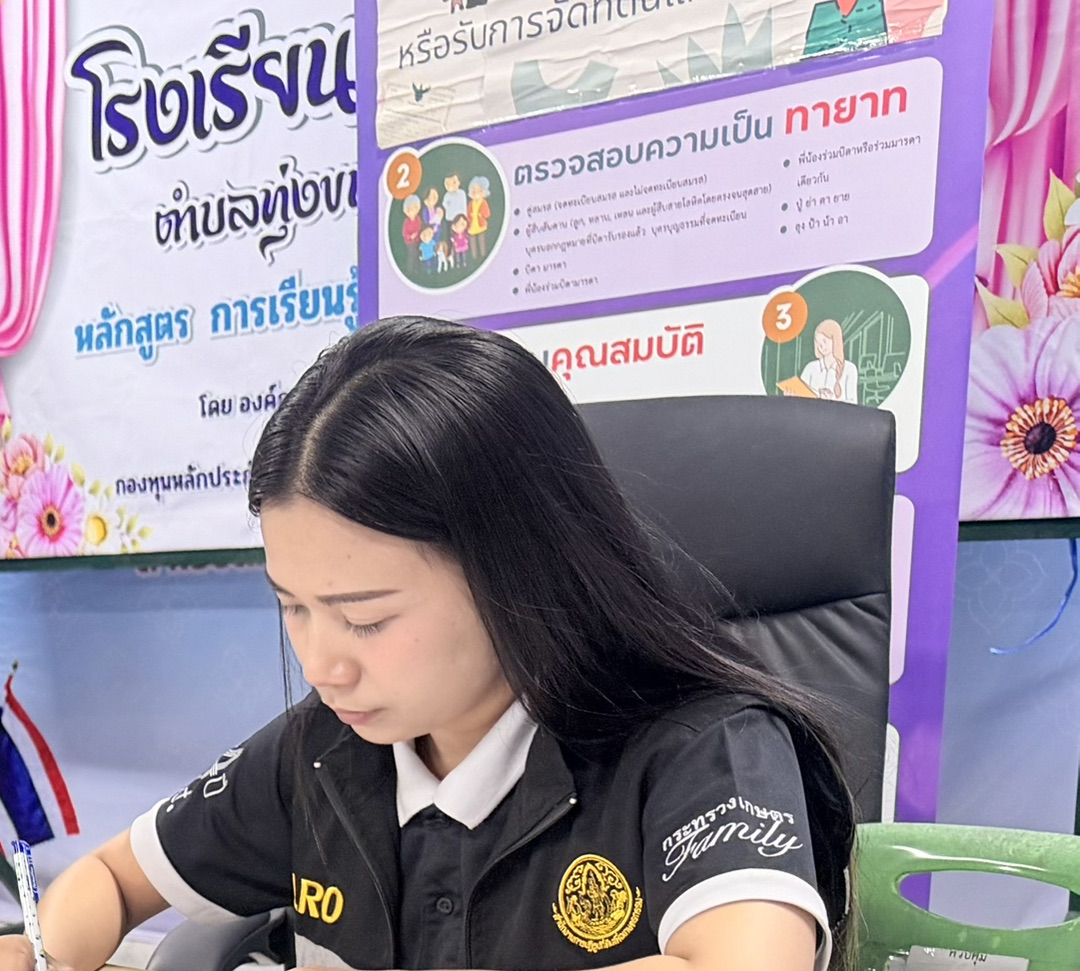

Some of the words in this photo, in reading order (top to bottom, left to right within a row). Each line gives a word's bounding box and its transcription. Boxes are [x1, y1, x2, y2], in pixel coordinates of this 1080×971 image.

[70, 24, 358, 162] โรงเรียน
[514, 108, 773, 186] ตรวจสอบความเป็น
[784, 85, 908, 135] ทายาท
[396, 163, 411, 190] 2
[833, 192, 850, 203] ยาย
[837, 214, 849, 225] อา
[75, 306, 190, 361] หลักสูตร
[775, 303, 793, 331] 3
[199, 394, 232, 417] โดย
[662, 796, 795, 851] กระทรวงเกษตร
[662, 820, 803, 882] Family
